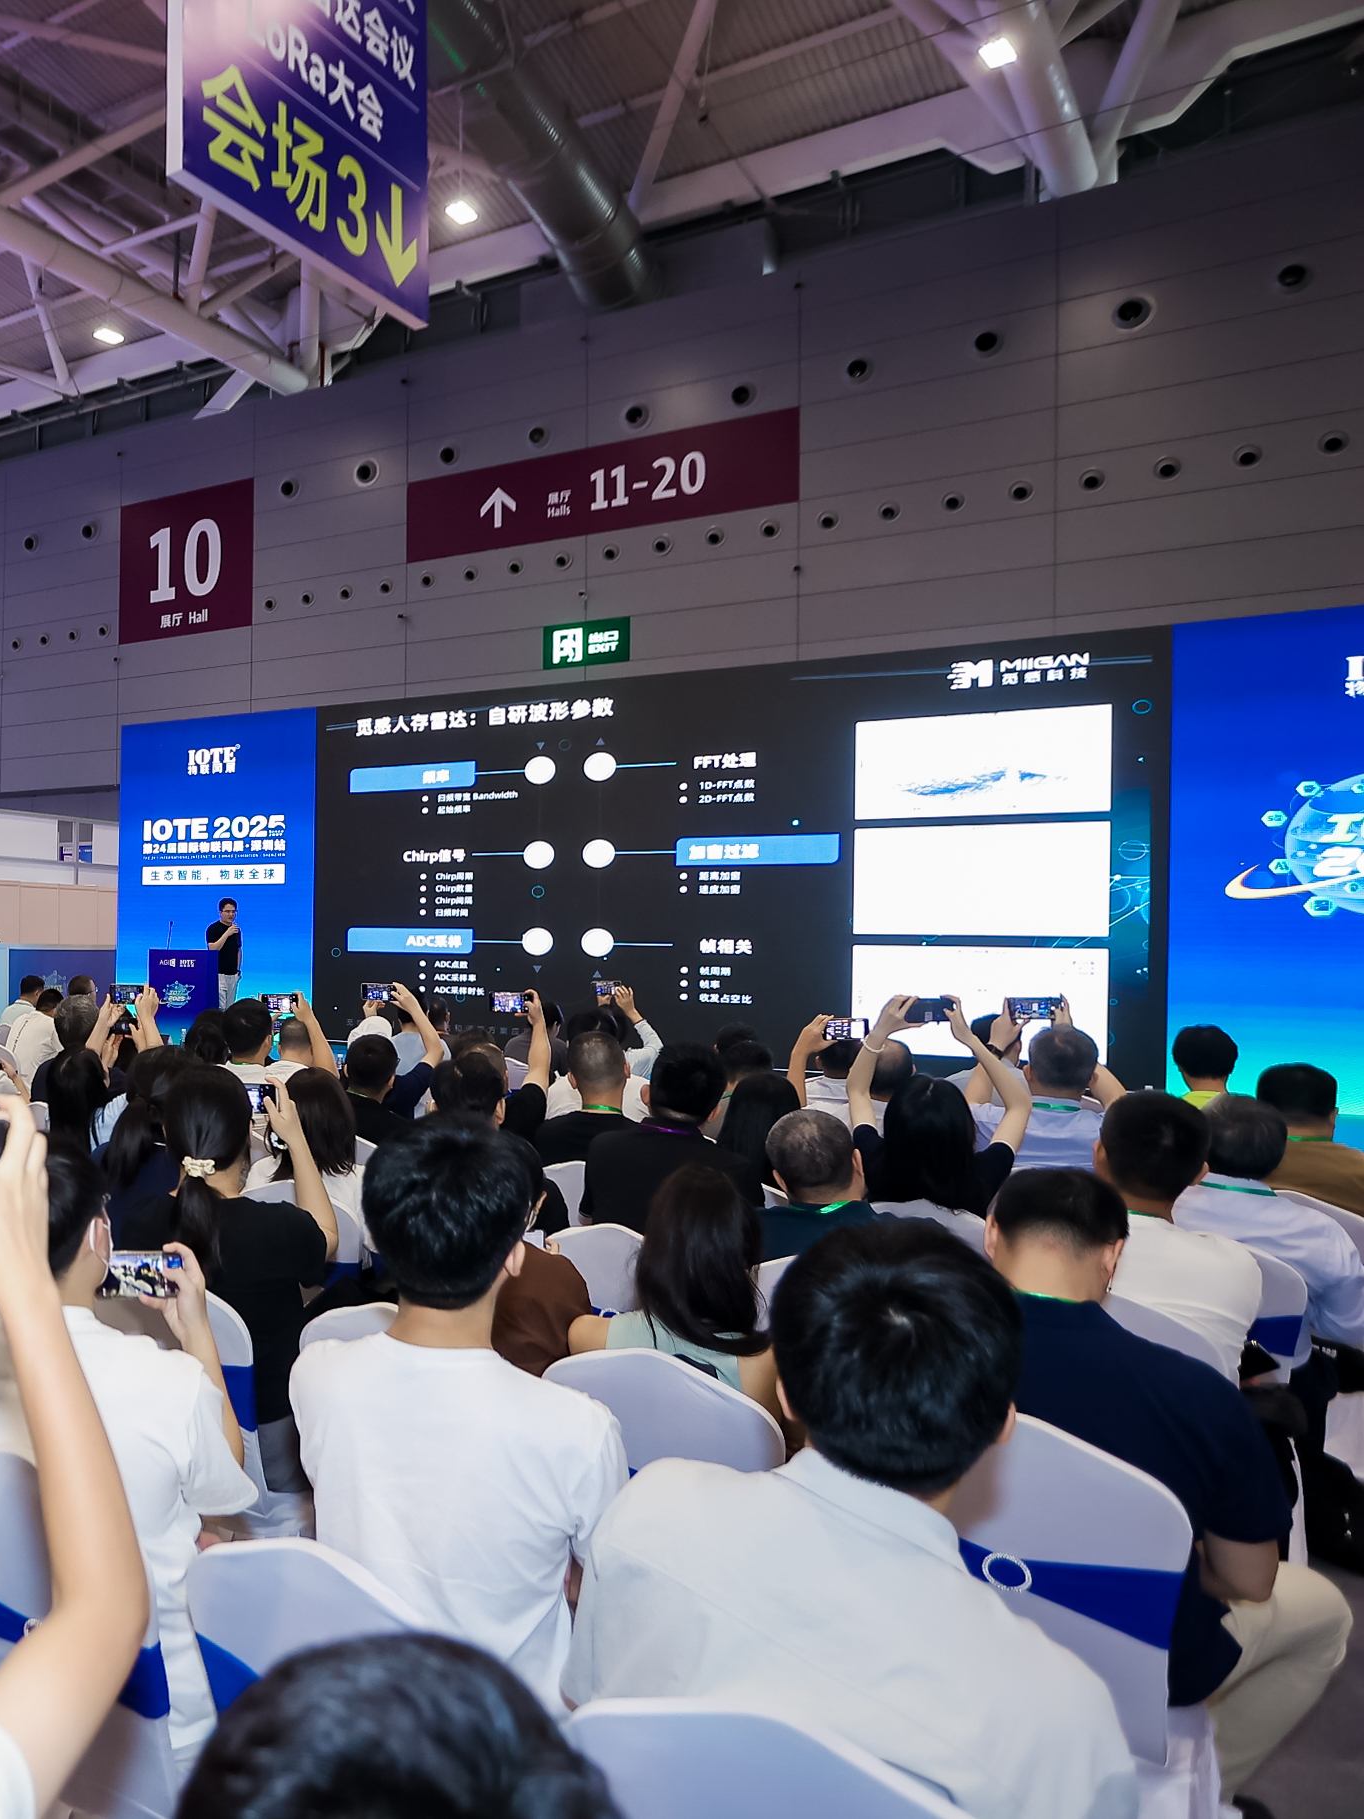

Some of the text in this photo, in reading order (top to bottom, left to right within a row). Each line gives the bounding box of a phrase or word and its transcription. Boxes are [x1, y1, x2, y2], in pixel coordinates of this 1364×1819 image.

[201, 63, 368, 257] 会场3
[590, 450, 706, 511] 11-20
[547, 505, 571, 518] Halls
[149, 518, 222, 604] 10
[160, 608, 209, 629] 展厅 Hall
[587, 641, 619, 655] EXIT
[188, 746, 237, 766] IOTE
[693, 751, 757, 769] FFT处理
[472, 790, 519, 801] Bandwidth
[143, 814, 286, 841] IOTE 2025
[402, 849, 466, 864] Chirp信号
